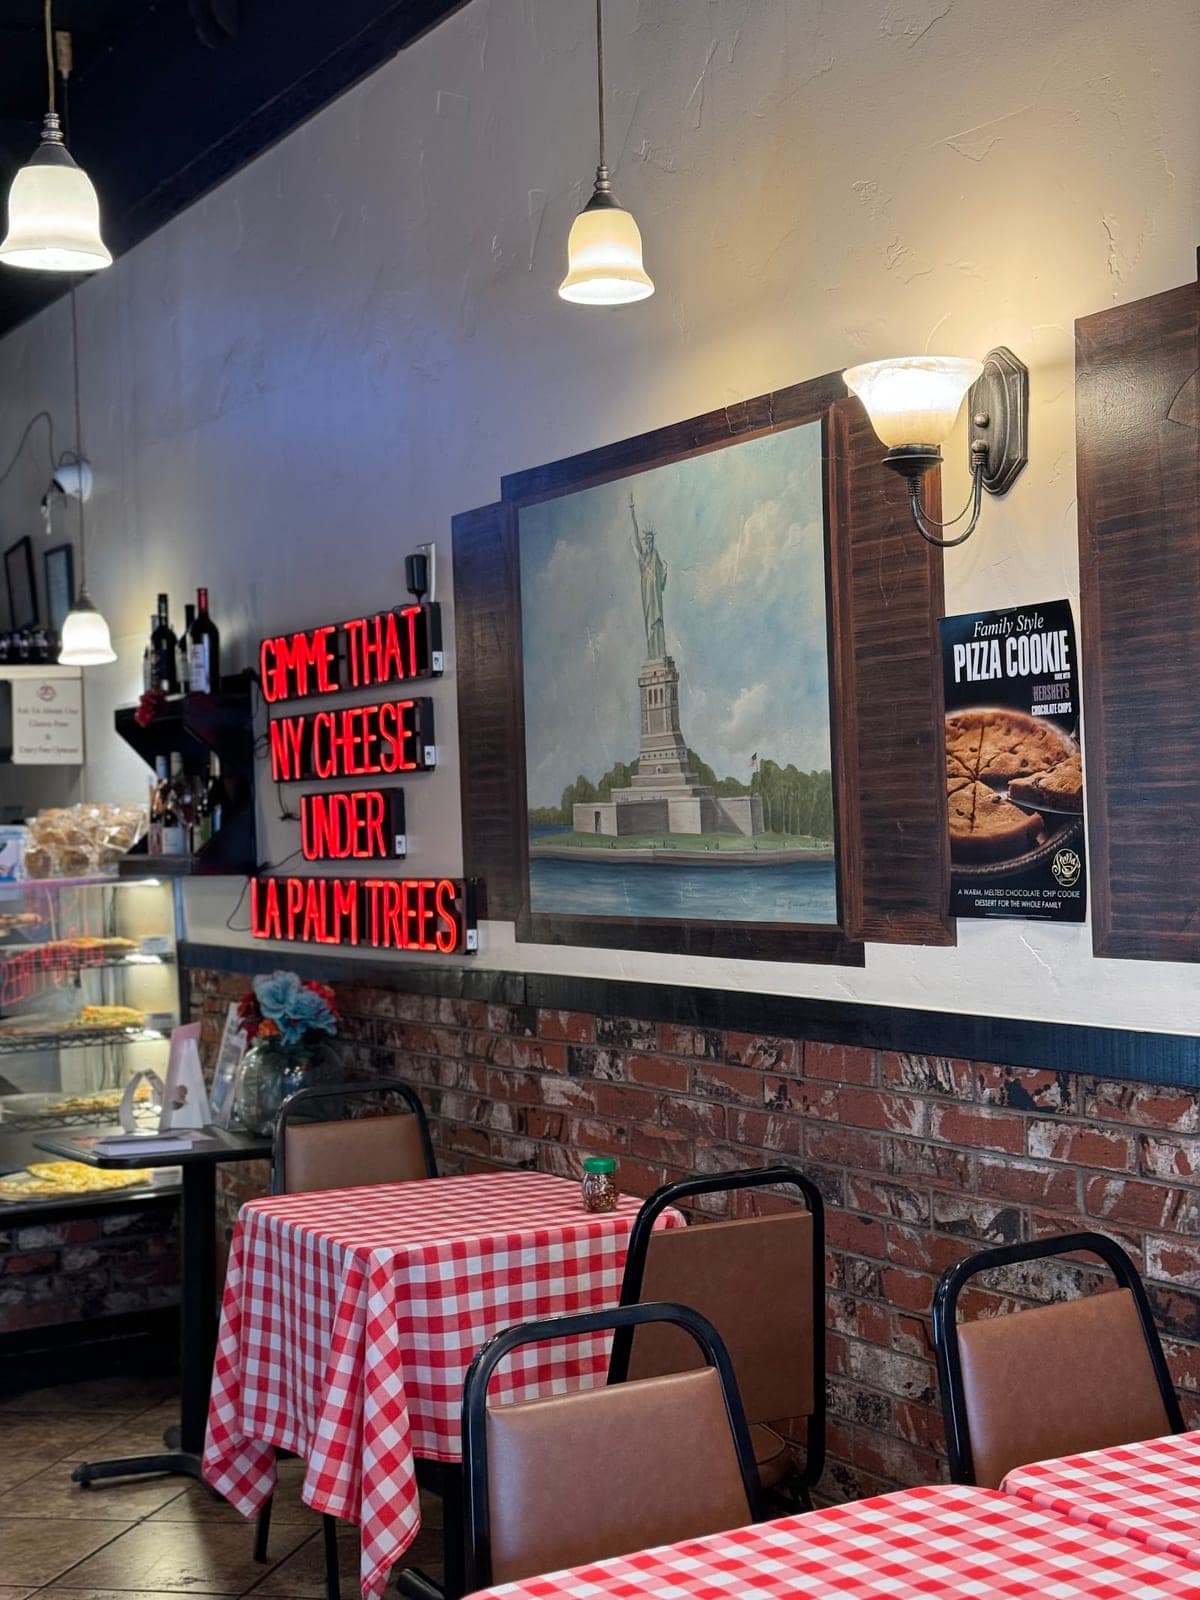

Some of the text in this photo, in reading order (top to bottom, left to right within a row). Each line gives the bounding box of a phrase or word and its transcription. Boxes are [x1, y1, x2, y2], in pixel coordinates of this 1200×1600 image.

[260, 625, 339, 704] GIMME
[343, 606, 421, 687] THAT
[973, 612, 1044, 638] Family Style
[953, 630, 1070, 682] PIZZA COOKIE
[270, 701, 417, 782] NY CHEESE
[301, 792, 386, 860] UNDER
[251, 876, 456, 953] LA PALM TREES
[974, 899, 997, 907] DESSERT
[998, 899, 1009, 907] FOR
[1021, 900, 1040, 908] WHOLE
[1042, 900, 1062, 909] FAMILY
[984, 889, 1004, 897] MELTED
[1005, 889, 1040, 897] CHOCOLATE
[1057, 890, 1080, 898] COOKIE
